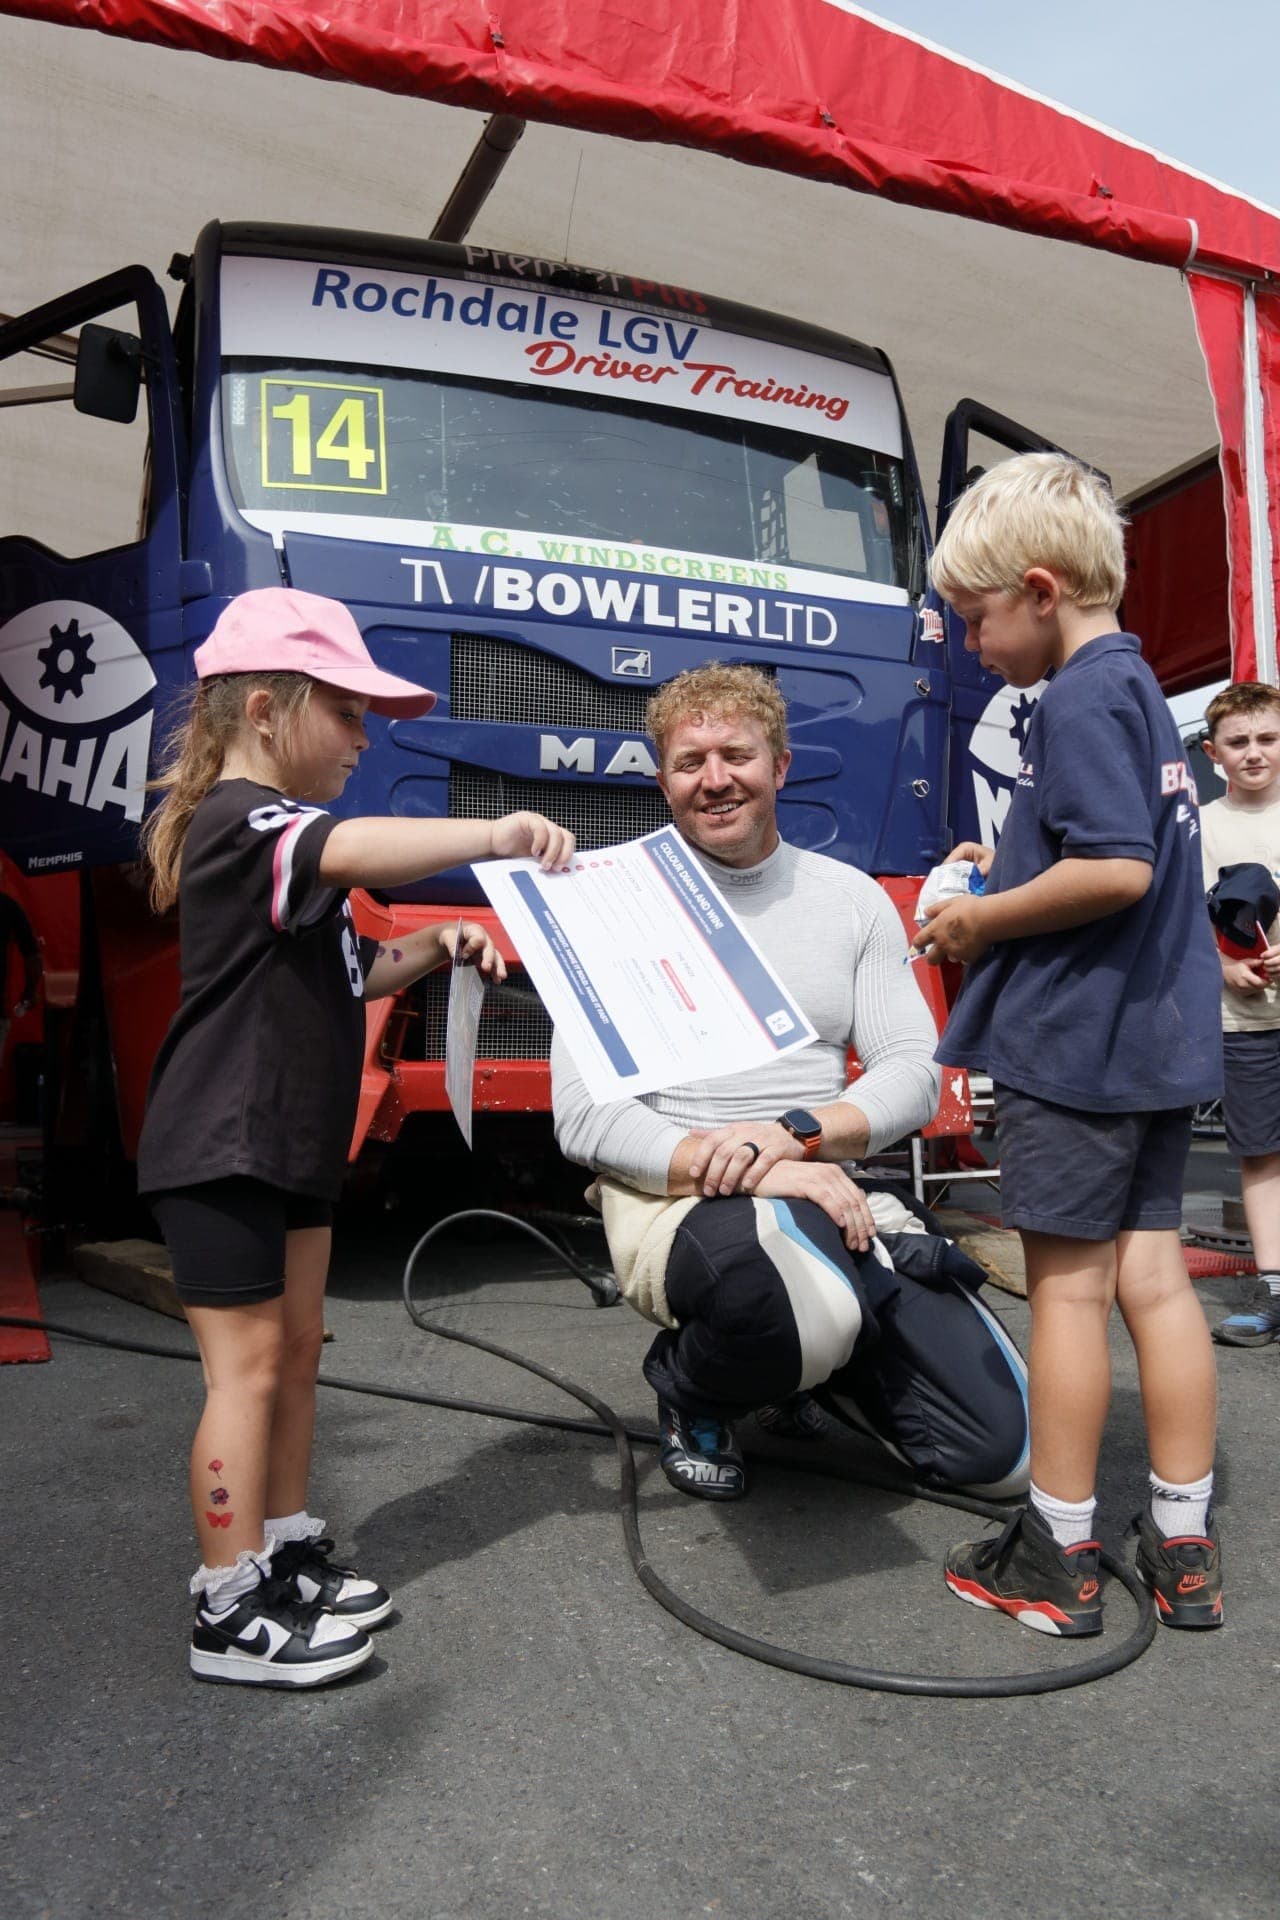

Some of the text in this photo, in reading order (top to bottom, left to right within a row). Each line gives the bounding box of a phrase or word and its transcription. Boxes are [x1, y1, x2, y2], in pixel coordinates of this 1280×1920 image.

[464, 245, 624, 293] Premer
[312, 268, 579, 341] Rochdale
[598, 310, 699, 361] LGV
[525, 340, 850, 423] Driver Training
[272, 394, 375, 480] 14
[538, 541, 788, 591] WINDSCREENS
[0, 702, 154, 824] AHA
[540, 734, 657, 777] MA
[28, 852, 84, 869] MEMPHIS
[659, 841, 724, 931] COLOUR DIANA AND WIN!
[770, 1016, 787, 1032] 14
[1182, 1575, 1206, 1585] NIKE
